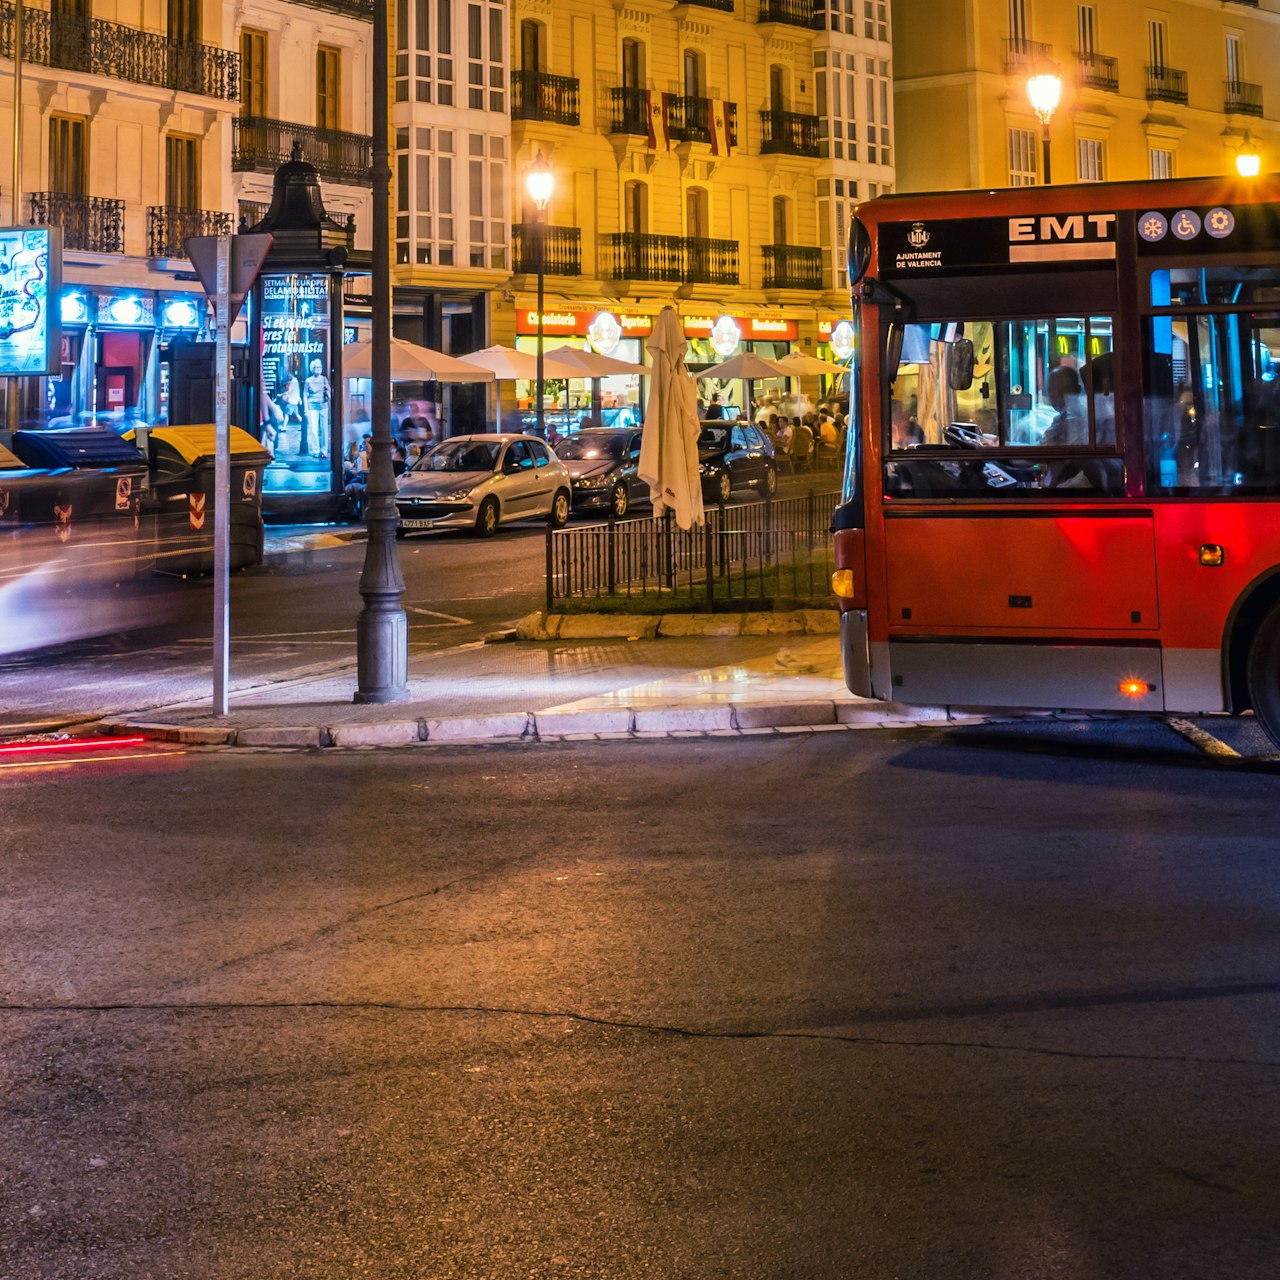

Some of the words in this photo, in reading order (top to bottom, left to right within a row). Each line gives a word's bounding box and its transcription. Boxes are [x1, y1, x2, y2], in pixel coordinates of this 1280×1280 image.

[1008, 214, 1116, 241] EMT
[896, 252, 942, 261] AJUNTAMENT
[907, 259, 942, 268] VALENCIA
[263, 316, 272, 328] Si
[263, 330, 283, 341] eres
[262, 341, 324, 356] protagonista
